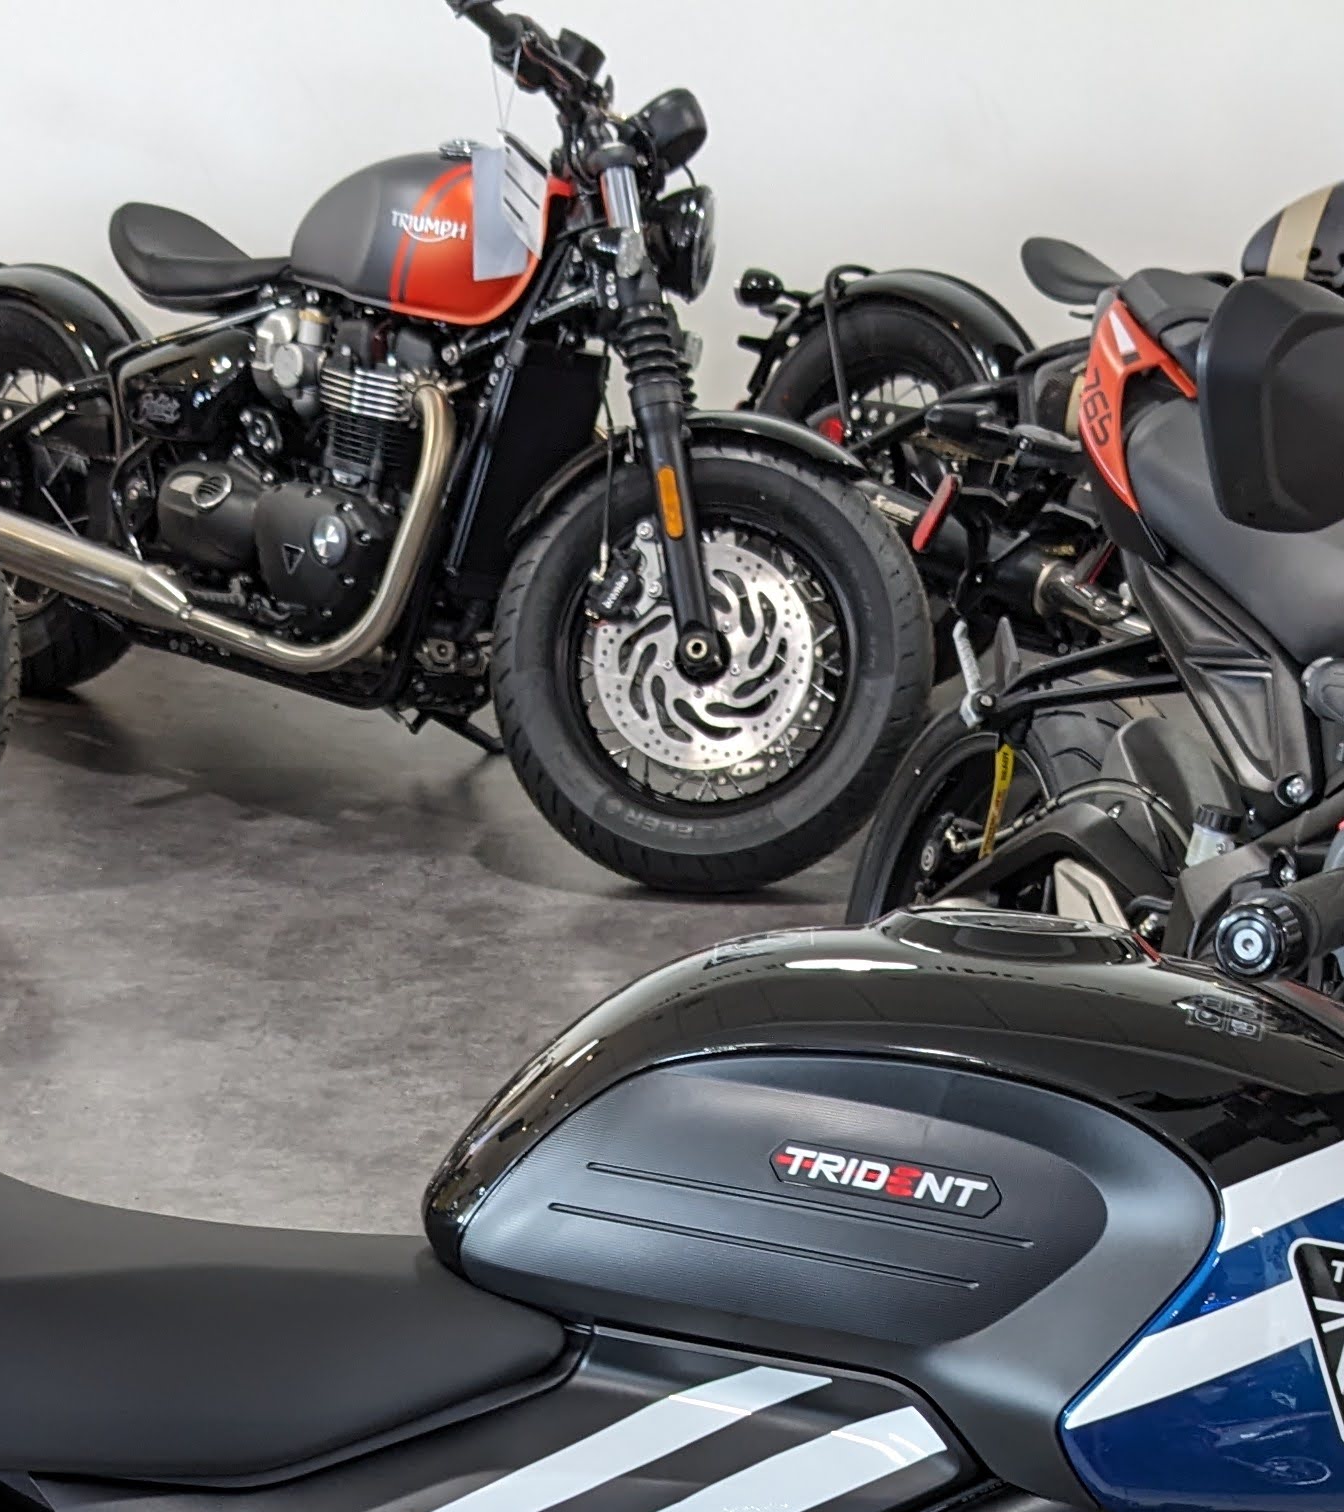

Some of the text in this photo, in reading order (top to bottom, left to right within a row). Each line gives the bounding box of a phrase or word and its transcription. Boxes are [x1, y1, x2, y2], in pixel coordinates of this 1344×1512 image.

[391, 210, 467, 242] TRIUMPH
[1082, 366, 1112, 446] 765
[776, 1146, 988, 1207] TRIDENT
